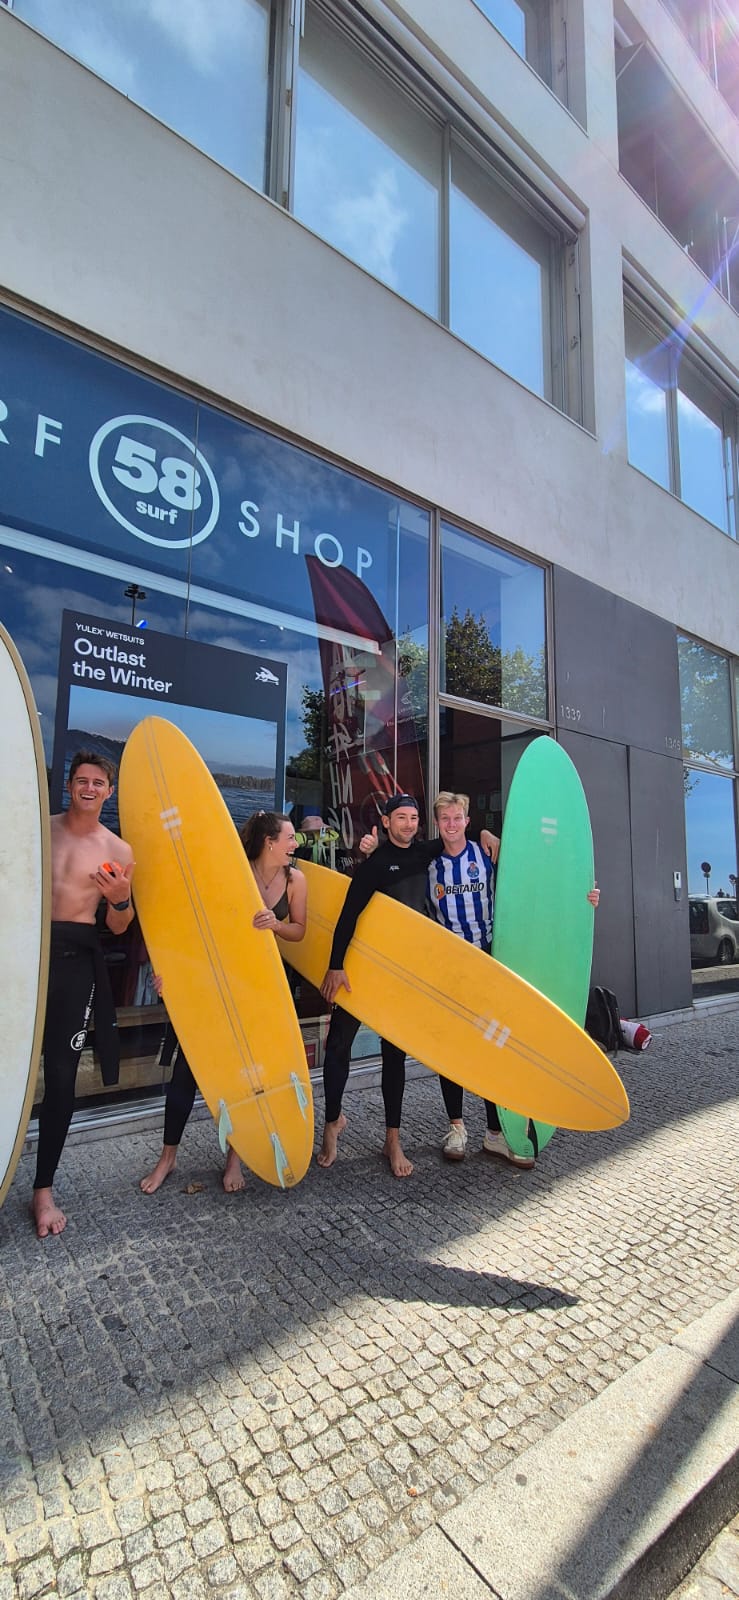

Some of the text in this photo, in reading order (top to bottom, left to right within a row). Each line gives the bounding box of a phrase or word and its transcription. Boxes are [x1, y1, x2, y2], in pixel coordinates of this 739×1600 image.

[111, 435, 202, 510] 58
[136, 500, 178, 525] surf
[238, 500, 373, 578] SHOP
[105, 630, 145, 645] WETSUITS
[74, 637, 147, 668] Outlast
[72, 660, 173, 694] the Winter
[560, 704, 581, 721] 1339
[446, 882, 485, 895] BETANO
